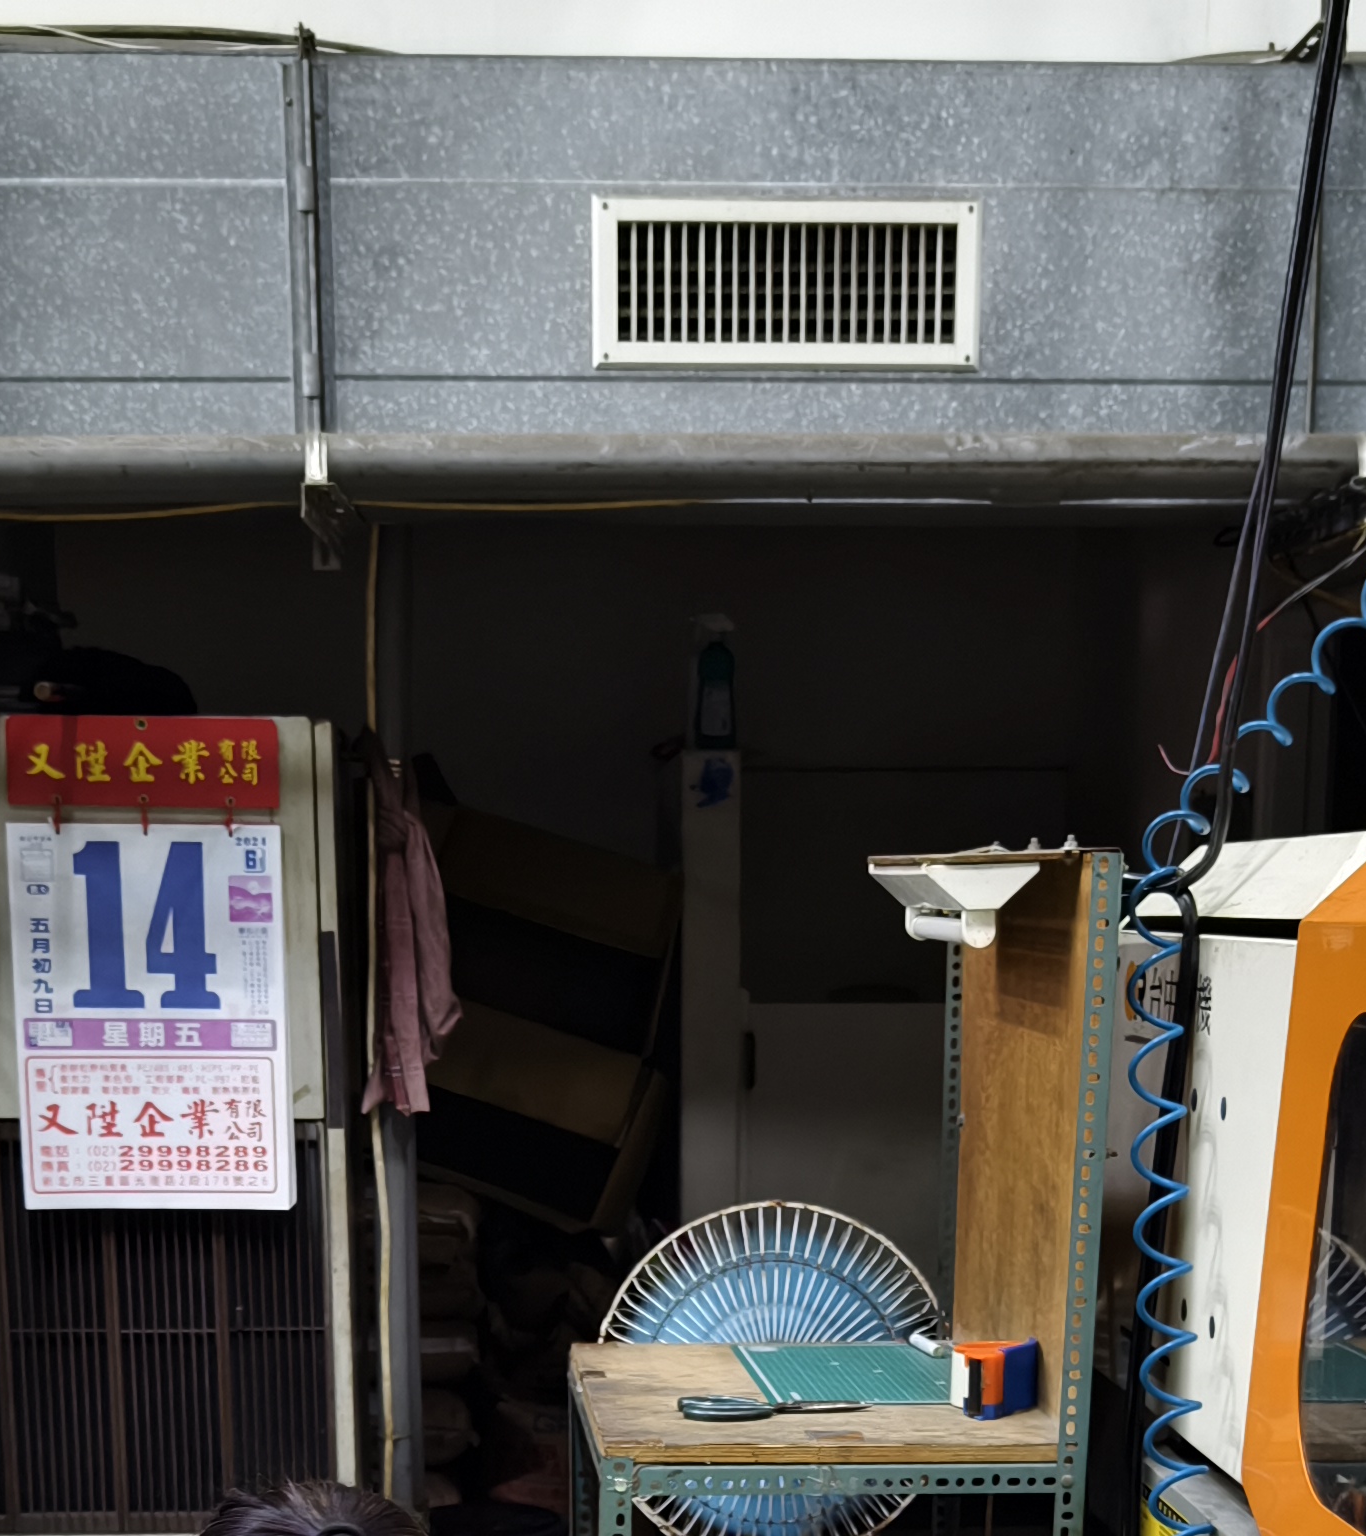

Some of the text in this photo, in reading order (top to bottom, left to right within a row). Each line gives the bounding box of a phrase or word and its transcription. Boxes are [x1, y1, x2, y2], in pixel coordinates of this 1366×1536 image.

[29, 917, 54, 1013] 五月初九日
[73, 840, 221, 1009] 14
[103, 1021, 202, 1048] 星期五
